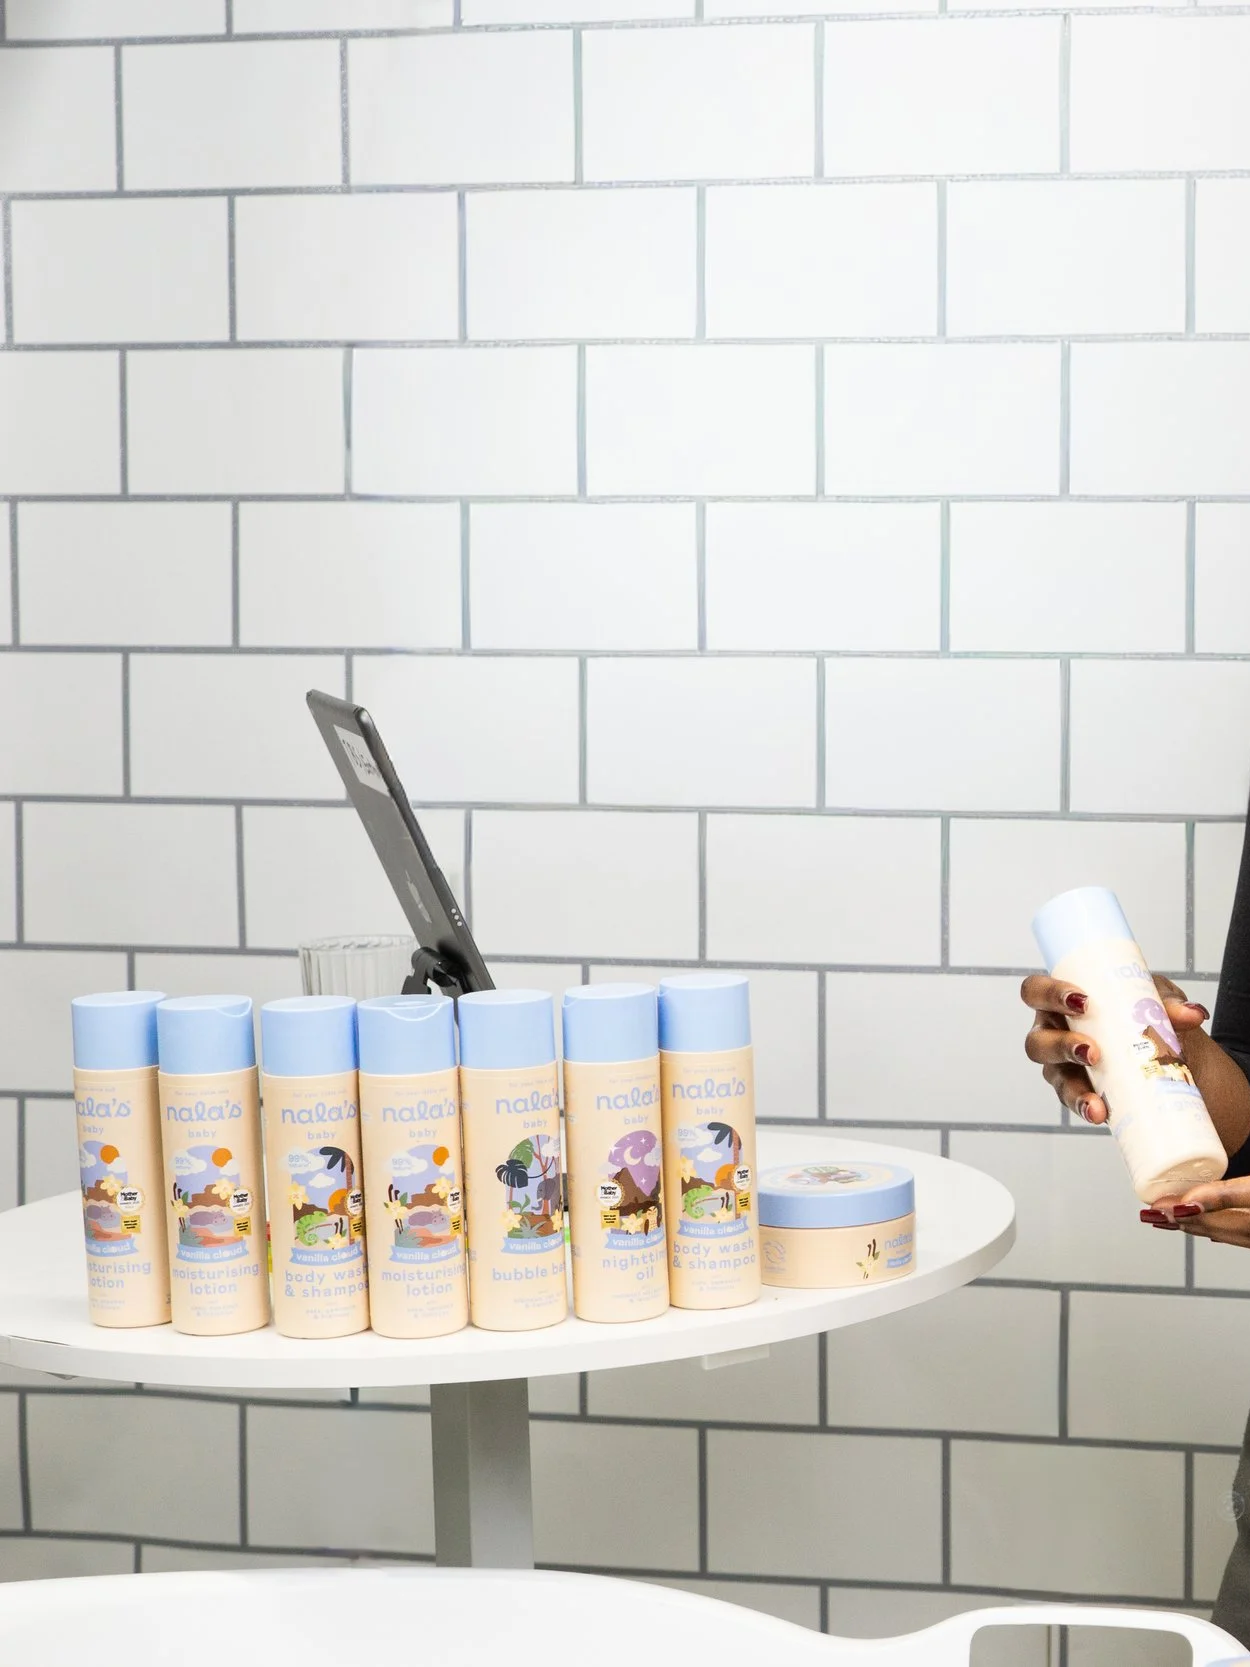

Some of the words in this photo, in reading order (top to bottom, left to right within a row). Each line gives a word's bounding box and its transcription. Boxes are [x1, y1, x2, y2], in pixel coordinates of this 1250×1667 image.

[672, 1077, 746, 1099] nala's
[76, 1097, 131, 1118] ala's
[166, 1099, 242, 1122] nala's
[281, 1100, 357, 1124] nala's
[382, 1098, 456, 1122] nala's
[696, 1105, 724, 1117] baby
[523, 1118, 547, 1129] baby
[624, 1114, 648, 1125] baby
[188, 1129, 217, 1140] baby
[307, 1131, 337, 1141] baby
[409, 1128, 437, 1139] baby
[288, 1154, 309, 1163] 99%
[683, 1224, 716, 1235] vanilla
[717, 1221, 745, 1235] cloud
[510, 1242, 541, 1251] vanilla
[612, 1237, 645, 1247] vanilla
[673, 1240, 711, 1258] body
[719, 1236, 754, 1254] wash
[180, 1250, 210, 1260] vanilla
[213, 1246, 243, 1260] cloud
[296, 1252, 329, 1263] vanilla
[331, 1246, 358, 1262] cloud
[396, 1250, 430, 1261] vanilla
[431, 1244, 457, 1260] cloud
[673, 1255, 682, 1268] &
[688, 1254, 756, 1271] shampoo
[172, 1263, 259, 1281] moisturising
[285, 1269, 326, 1285] body
[492, 1265, 547, 1281] bubble
[636, 1265, 654, 1280] oil
[190, 1283, 238, 1296] lotion
[285, 1283, 295, 1297] &
[406, 1283, 453, 1297] lotion
